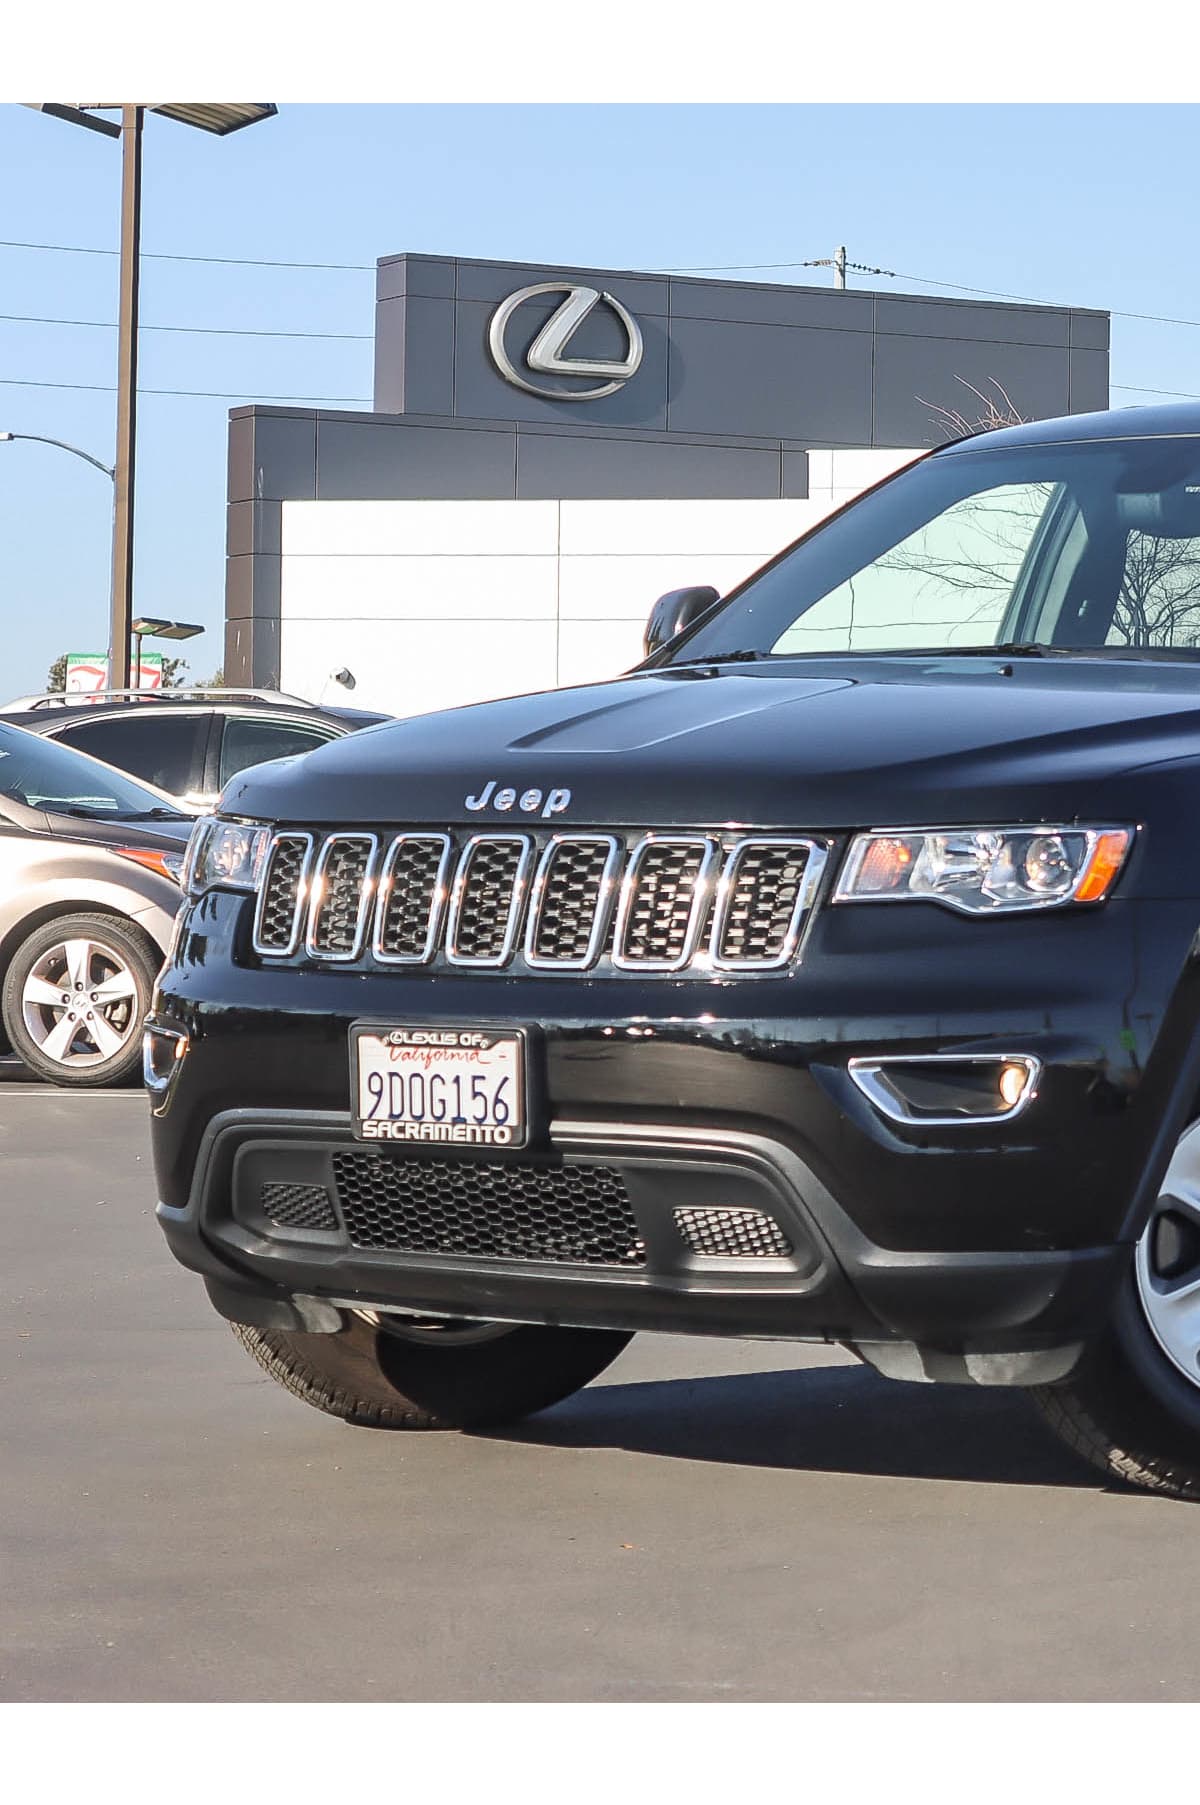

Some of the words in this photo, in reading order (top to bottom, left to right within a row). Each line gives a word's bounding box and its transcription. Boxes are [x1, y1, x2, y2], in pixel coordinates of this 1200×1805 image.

[465, 781, 571, 818] Jeep
[402, 1031, 459, 1046] LEXUS
[459, 1032, 482, 1046] OF
[390, 1046, 491, 1069] California
[362, 1120, 512, 1144] SACRAMENTO
